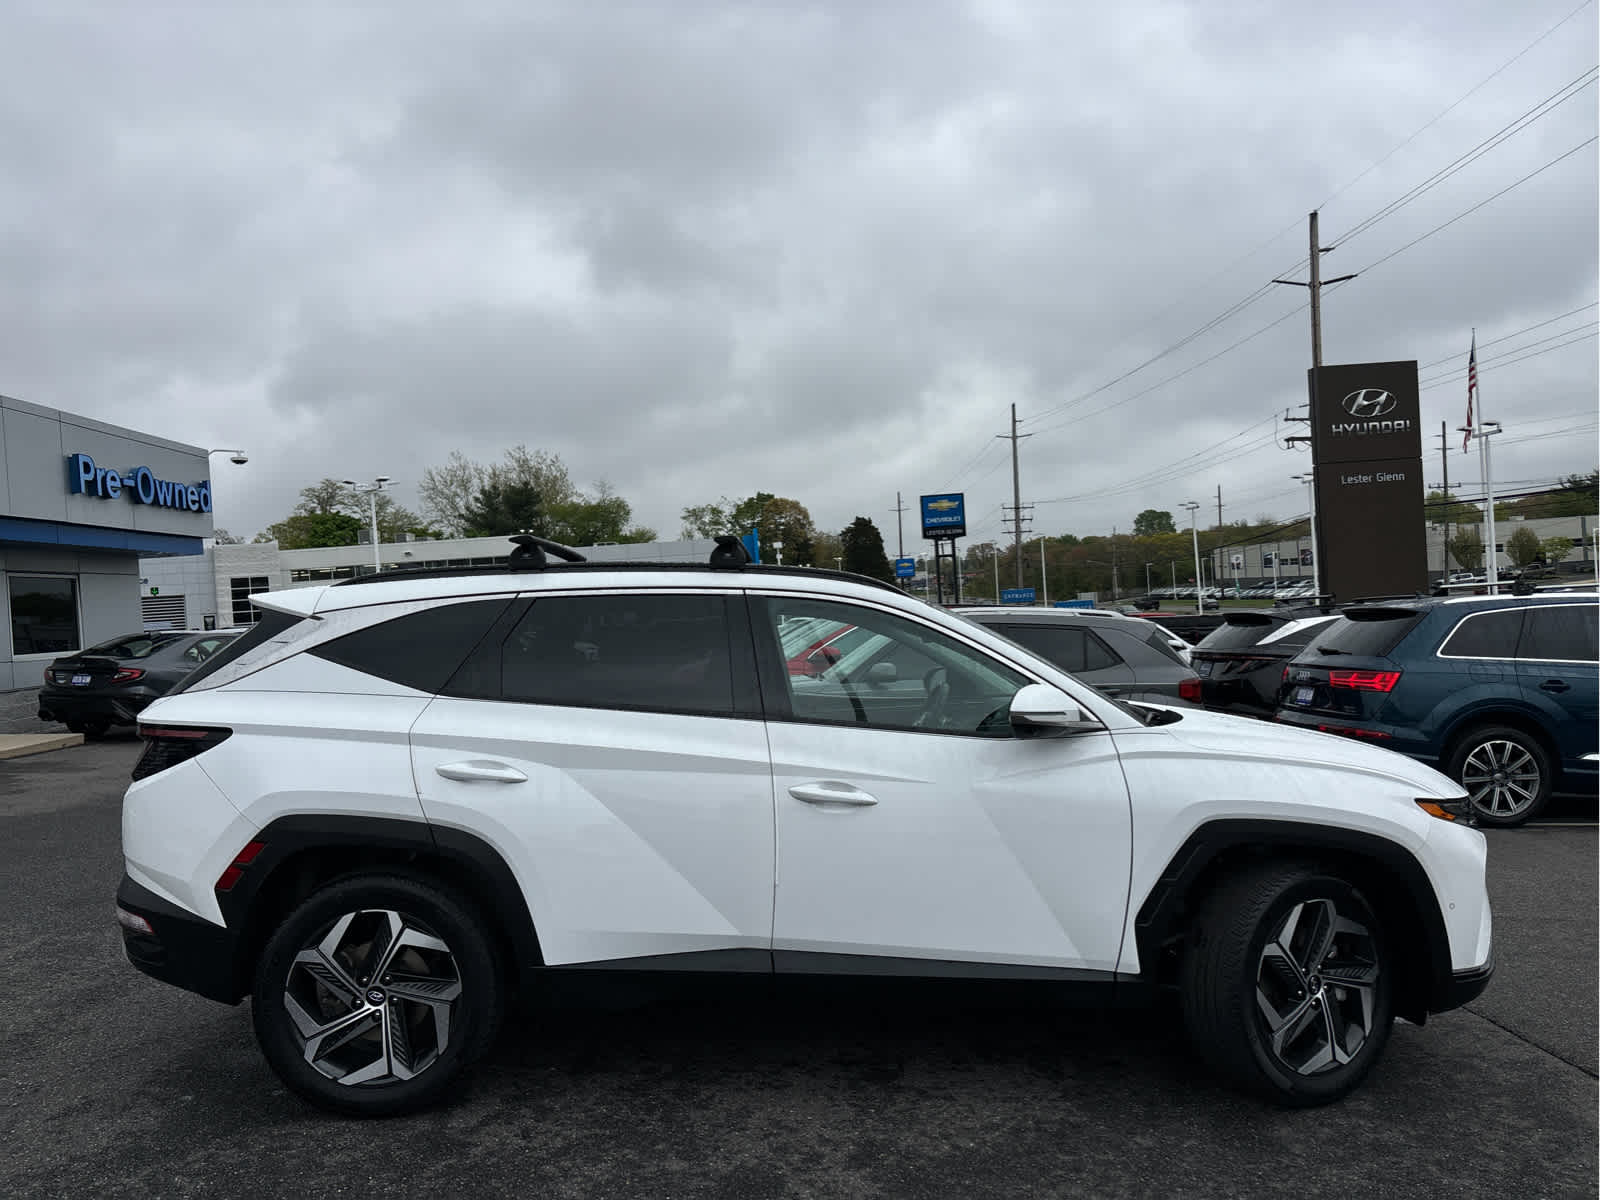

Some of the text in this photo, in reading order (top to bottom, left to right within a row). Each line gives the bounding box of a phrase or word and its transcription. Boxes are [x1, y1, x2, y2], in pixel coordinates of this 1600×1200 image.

[1331, 420, 1410, 435] HYUNDAI
[74, 453, 212, 512] Pre-Owned
[1341, 472, 1405, 485] Lester Glenn
